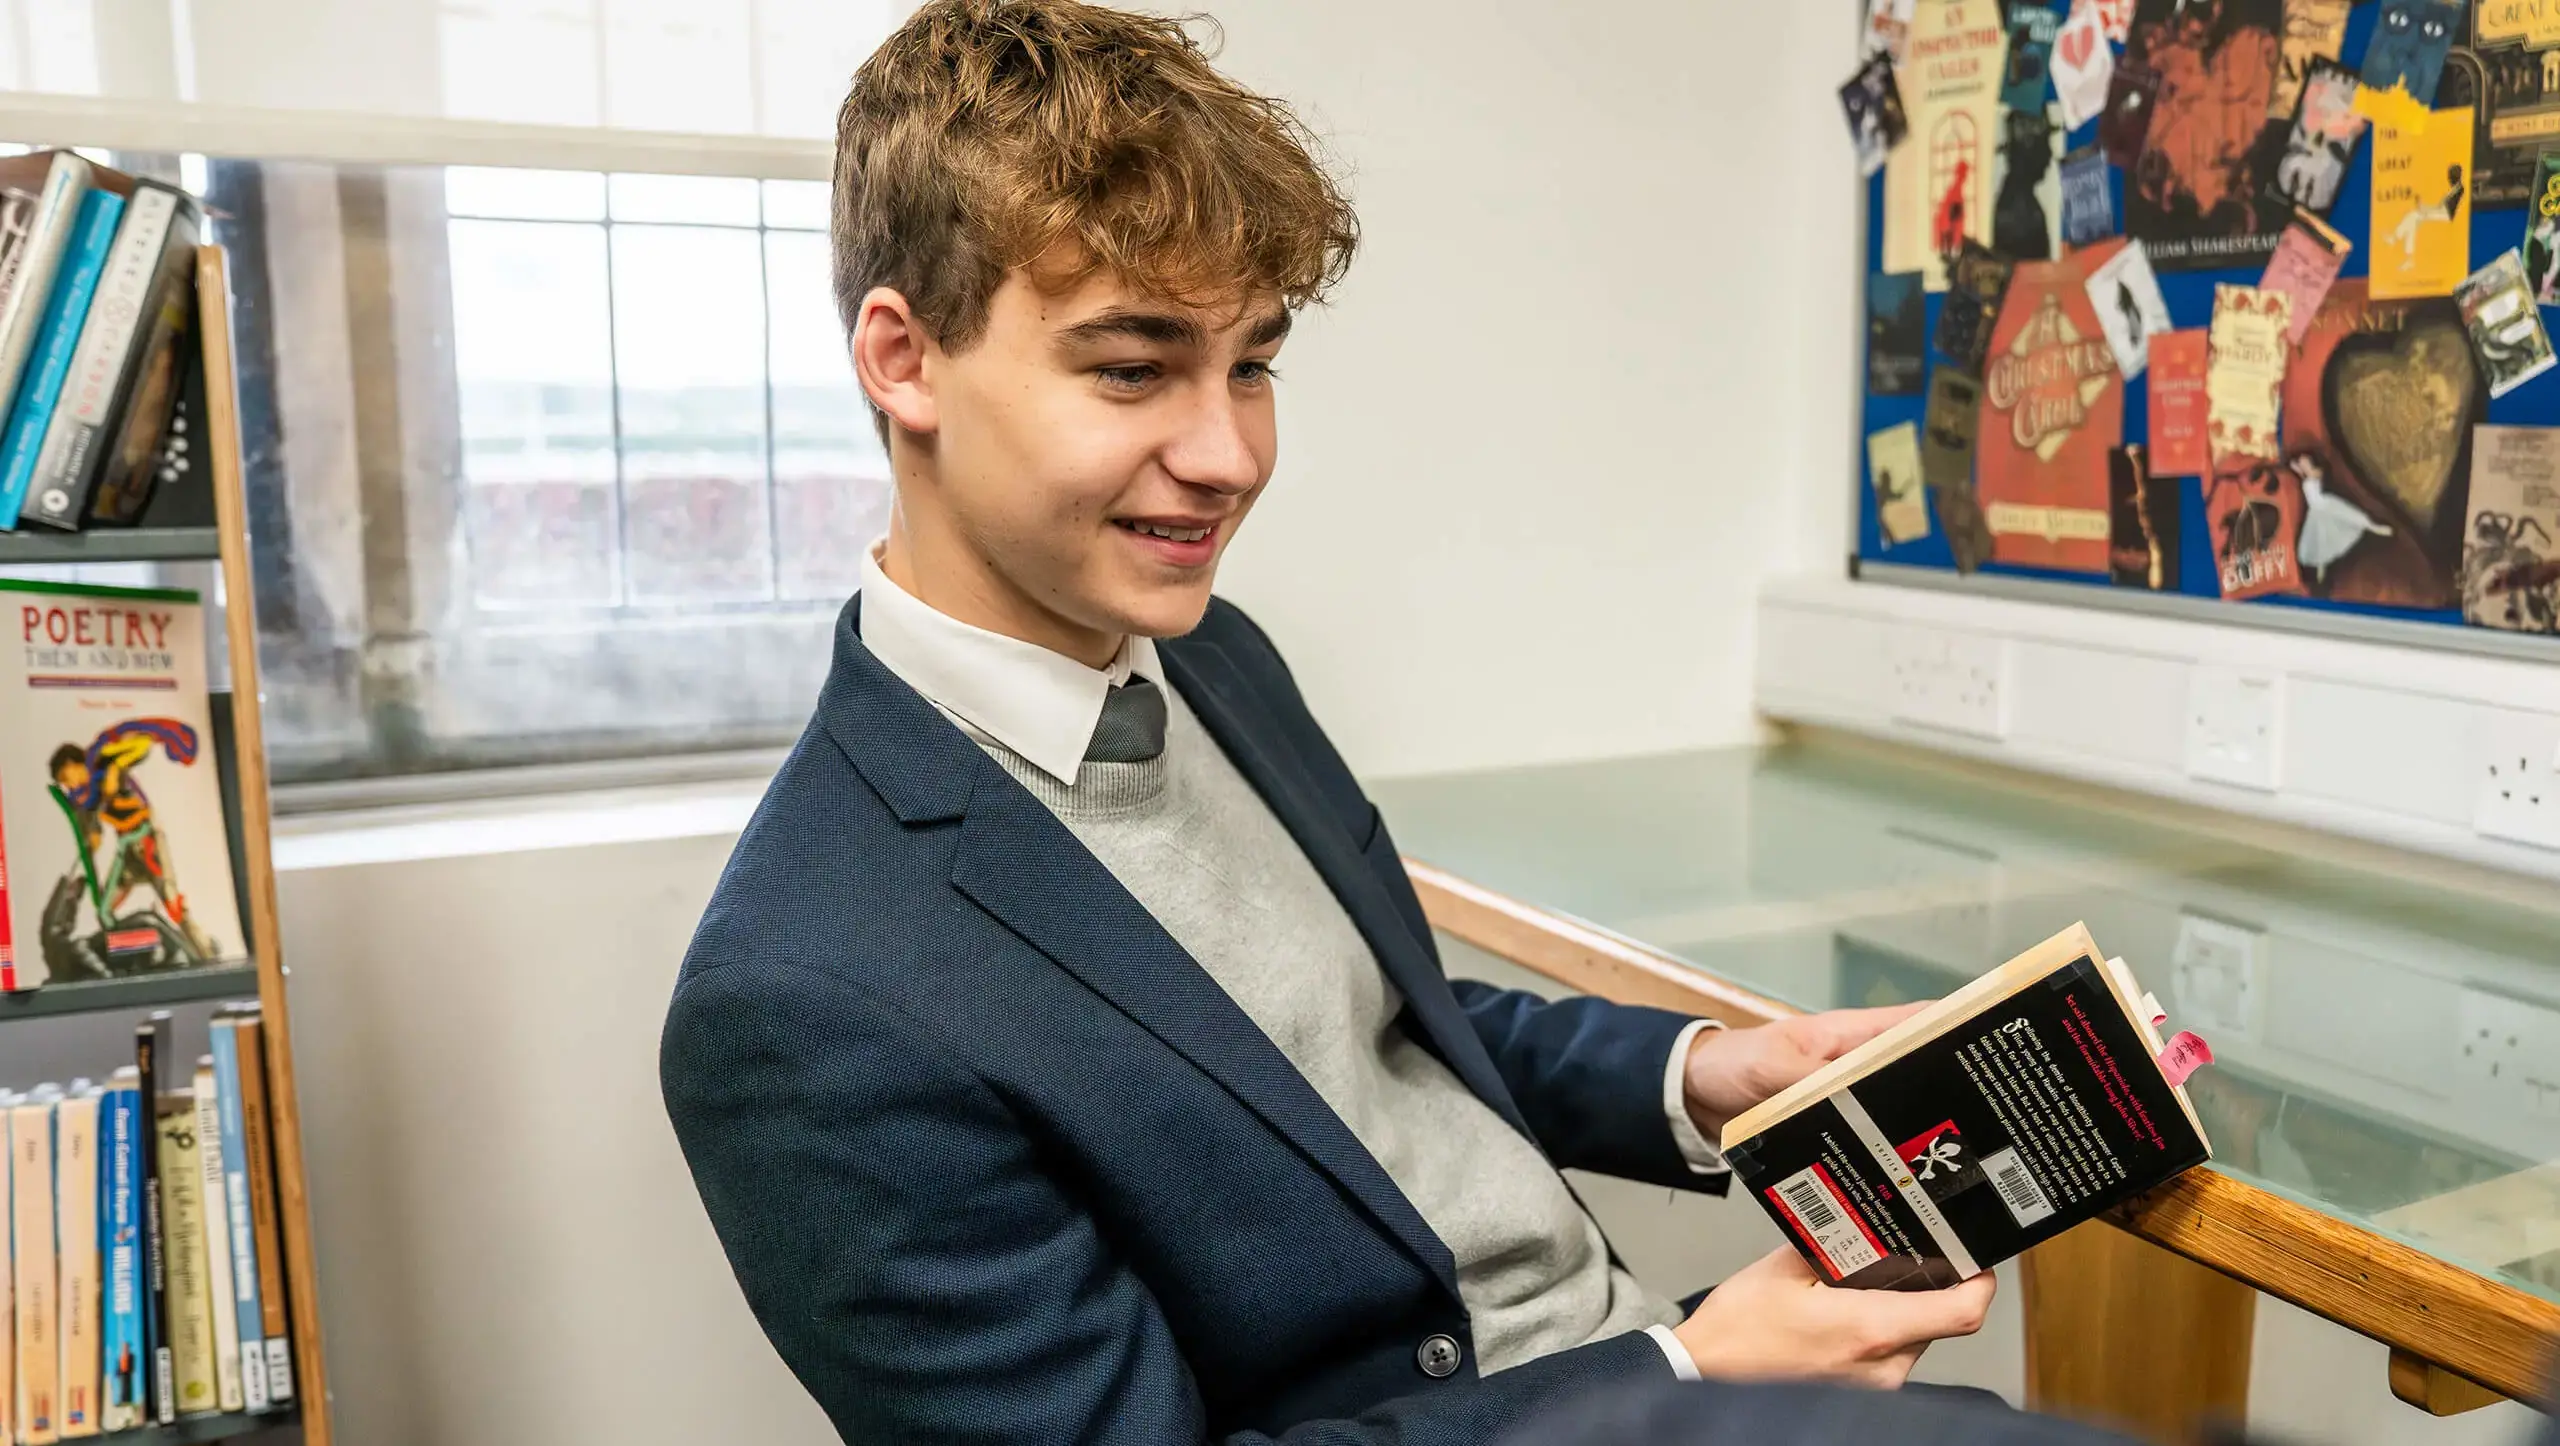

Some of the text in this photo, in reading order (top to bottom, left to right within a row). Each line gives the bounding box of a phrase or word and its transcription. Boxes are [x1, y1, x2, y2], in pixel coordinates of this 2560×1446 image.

[2140, 232, 2283, 260] ILLIAM SHAKESPEAR
[1988, 341, 2115, 410] CHRISTMAS
[21, 606, 173, 650] POETRY
[1954, 1050, 1973, 1073] mention
[1969, 1071, 1980, 1082] the
[1976, 1081, 1990, 1096] most
[1985, 1093, 2006, 1120] infamous
[2000, 1118, 2017, 1136] pirate
[2012, 1135, 2025, 1147] ever
[2020, 1146, 2029, 1155] to
[2025, 1153, 2037, 1165] sail
[2032, 1163, 2042, 1174] the
[2038, 1172, 2051, 1187] high
[1967, 1043, 1983, 1062] deadly
[1979, 1060, 1997, 1083] savages
[1992, 1081, 2009, 1098] stand
[2003, 1095, 2023, 1120] between
[2018, 1117, 2030, 1131] him
[2025, 1130, 2039, 1142] and
[2033, 1139, 2043, 1151] the
[2039, 1149, 2054, 1166] stash
[2049, 1164, 2060, 1172] of
[2062, 1184, 2074, 1197] Not
[2069, 1194, 2078, 1203] to
[1979, 1035, 1997, 1055] fabled
[1992, 1052, 2010, 1077] Treasure
[2019, 1095, 2032, 1108] But
[2031, 1111, 2044, 1126] host
[2039, 1125, 2050, 1133] of
[2059, 1154, 2072, 1168] wild
[2067, 1166, 2083, 1186] beasts
[2079, 1186, 2091, 1198] and
[2007, 1050, 2017, 1061] For
[2013, 1060, 2023, 1070] he
[2019, 1068, 2030, 1081] has
[2025, 1079, 2050, 1109] discovered
[2048, 1113, 2060, 1126] map
[2056, 1125, 2069, 1140] that
[2064, 1138, 2077, 1150] will
[2071, 1148, 2085, 1163] lead
[2080, 1160, 2091, 1174] him
[2087, 1172, 2096, 1181] to
[2092, 1179, 2102, 1191] the
[2020, 1048, 2038, 1068] young
[2033, 1065, 2045, 1078] Jim
[2042, 1077, 2060, 1102] Hawkins
[2057, 1100, 2070, 1116] finds
[2066, 1114, 2086, 1137] himself
[2080, 1136, 2093, 1151] with
[2088, 1150, 2099, 1162] the
[2096, 1160, 2106, 1172] key
[2102, 1171, 2111, 1180] to
[2040, 1050, 2051, 1062] the
[2048, 1063, 2065, 1084] demise
[2068, 1092, 2094, 1128] bloodthirsty
[2109, 1157, 2127, 1179] Captain
[1822, 1155, 1839, 1171] guide
[1835, 1169, 1844, 1177] to
[1860, 1202, 1881, 1226] activities
[1877, 1225, 1890, 1236] and
[1873, 1198, 1894, 1225] including
[1890, 1223, 1899, 1231] an
[1895, 1230, 1912, 1248] author
[1874, 1142, 1938, 1227] PUFFIN CLASSICS
